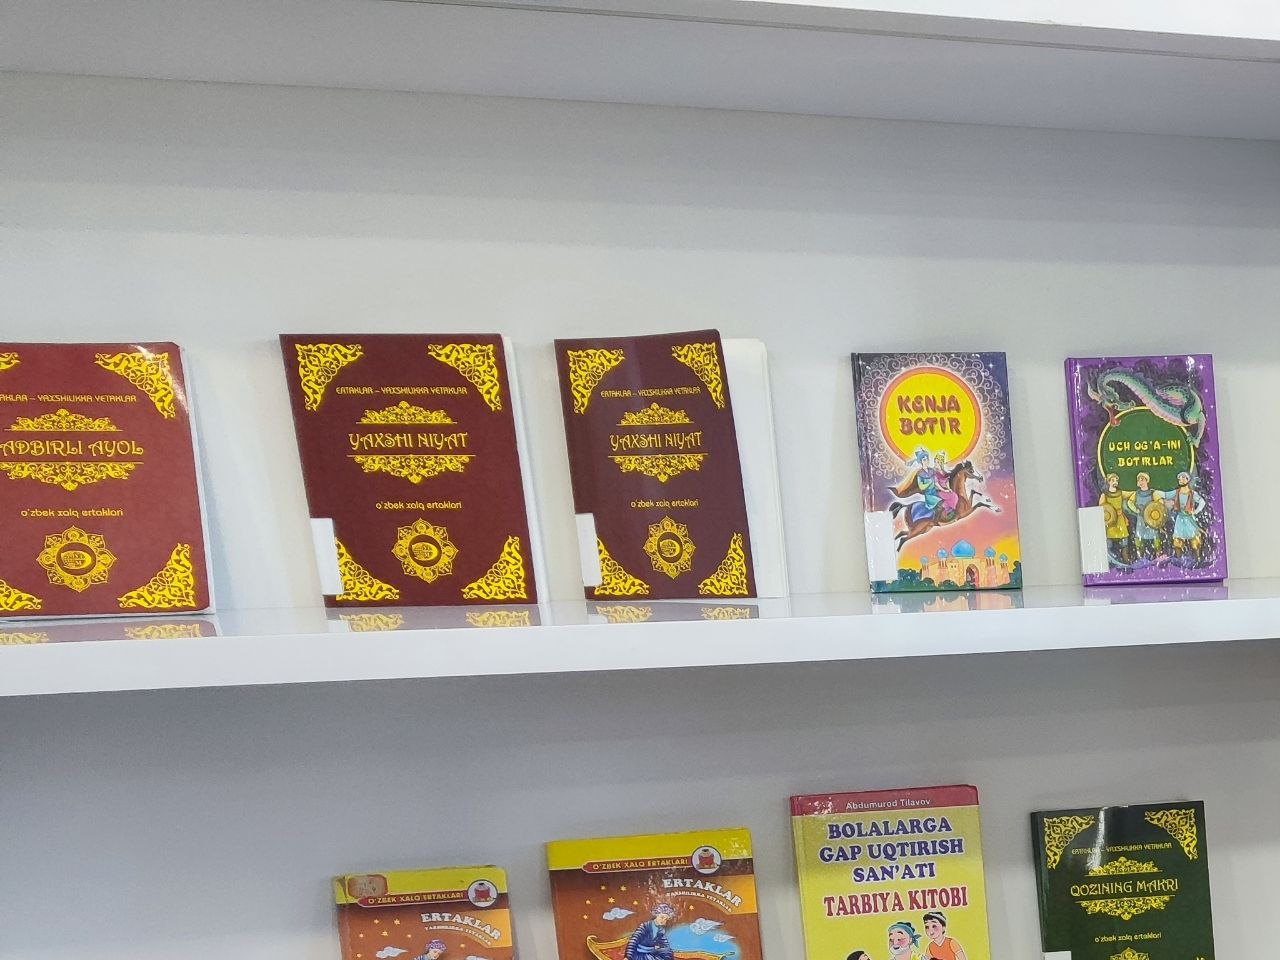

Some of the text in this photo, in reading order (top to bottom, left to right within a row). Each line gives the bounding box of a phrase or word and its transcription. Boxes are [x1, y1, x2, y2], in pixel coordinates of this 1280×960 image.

[95, 394, 137, 403] YETAKLAR
[897, 394, 961, 414] KENJA
[899, 416, 961, 436] BOTIR
[0, 440, 144, 457] ADBIRLI AYOL
[348, 432, 468, 451] YAXSHI NIYAT
[609, 430, 703, 452] YAXSHI NIYAT
[1108, 441, 1131, 452] UCH
[1117, 455, 1174, 467] BOTIRLAR
[20, 507, 124, 518] o'zbek xalq ertaklari
[375, 500, 462, 511] o'zbek xalq ertaklari
[846, 798, 931, 810] Abdumurod Tilavov
[828, 817, 953, 840] BOLALARGA
[819, 838, 964, 863] GAP UQTIRISH
[663, 878, 742, 907] ERTAKLAR
[1070, 878, 1180, 897] QOZINING MAKRI
[823, 886, 968, 917] TARBIYA KITOBI
[421, 912, 501, 940] ERTAKLAR
